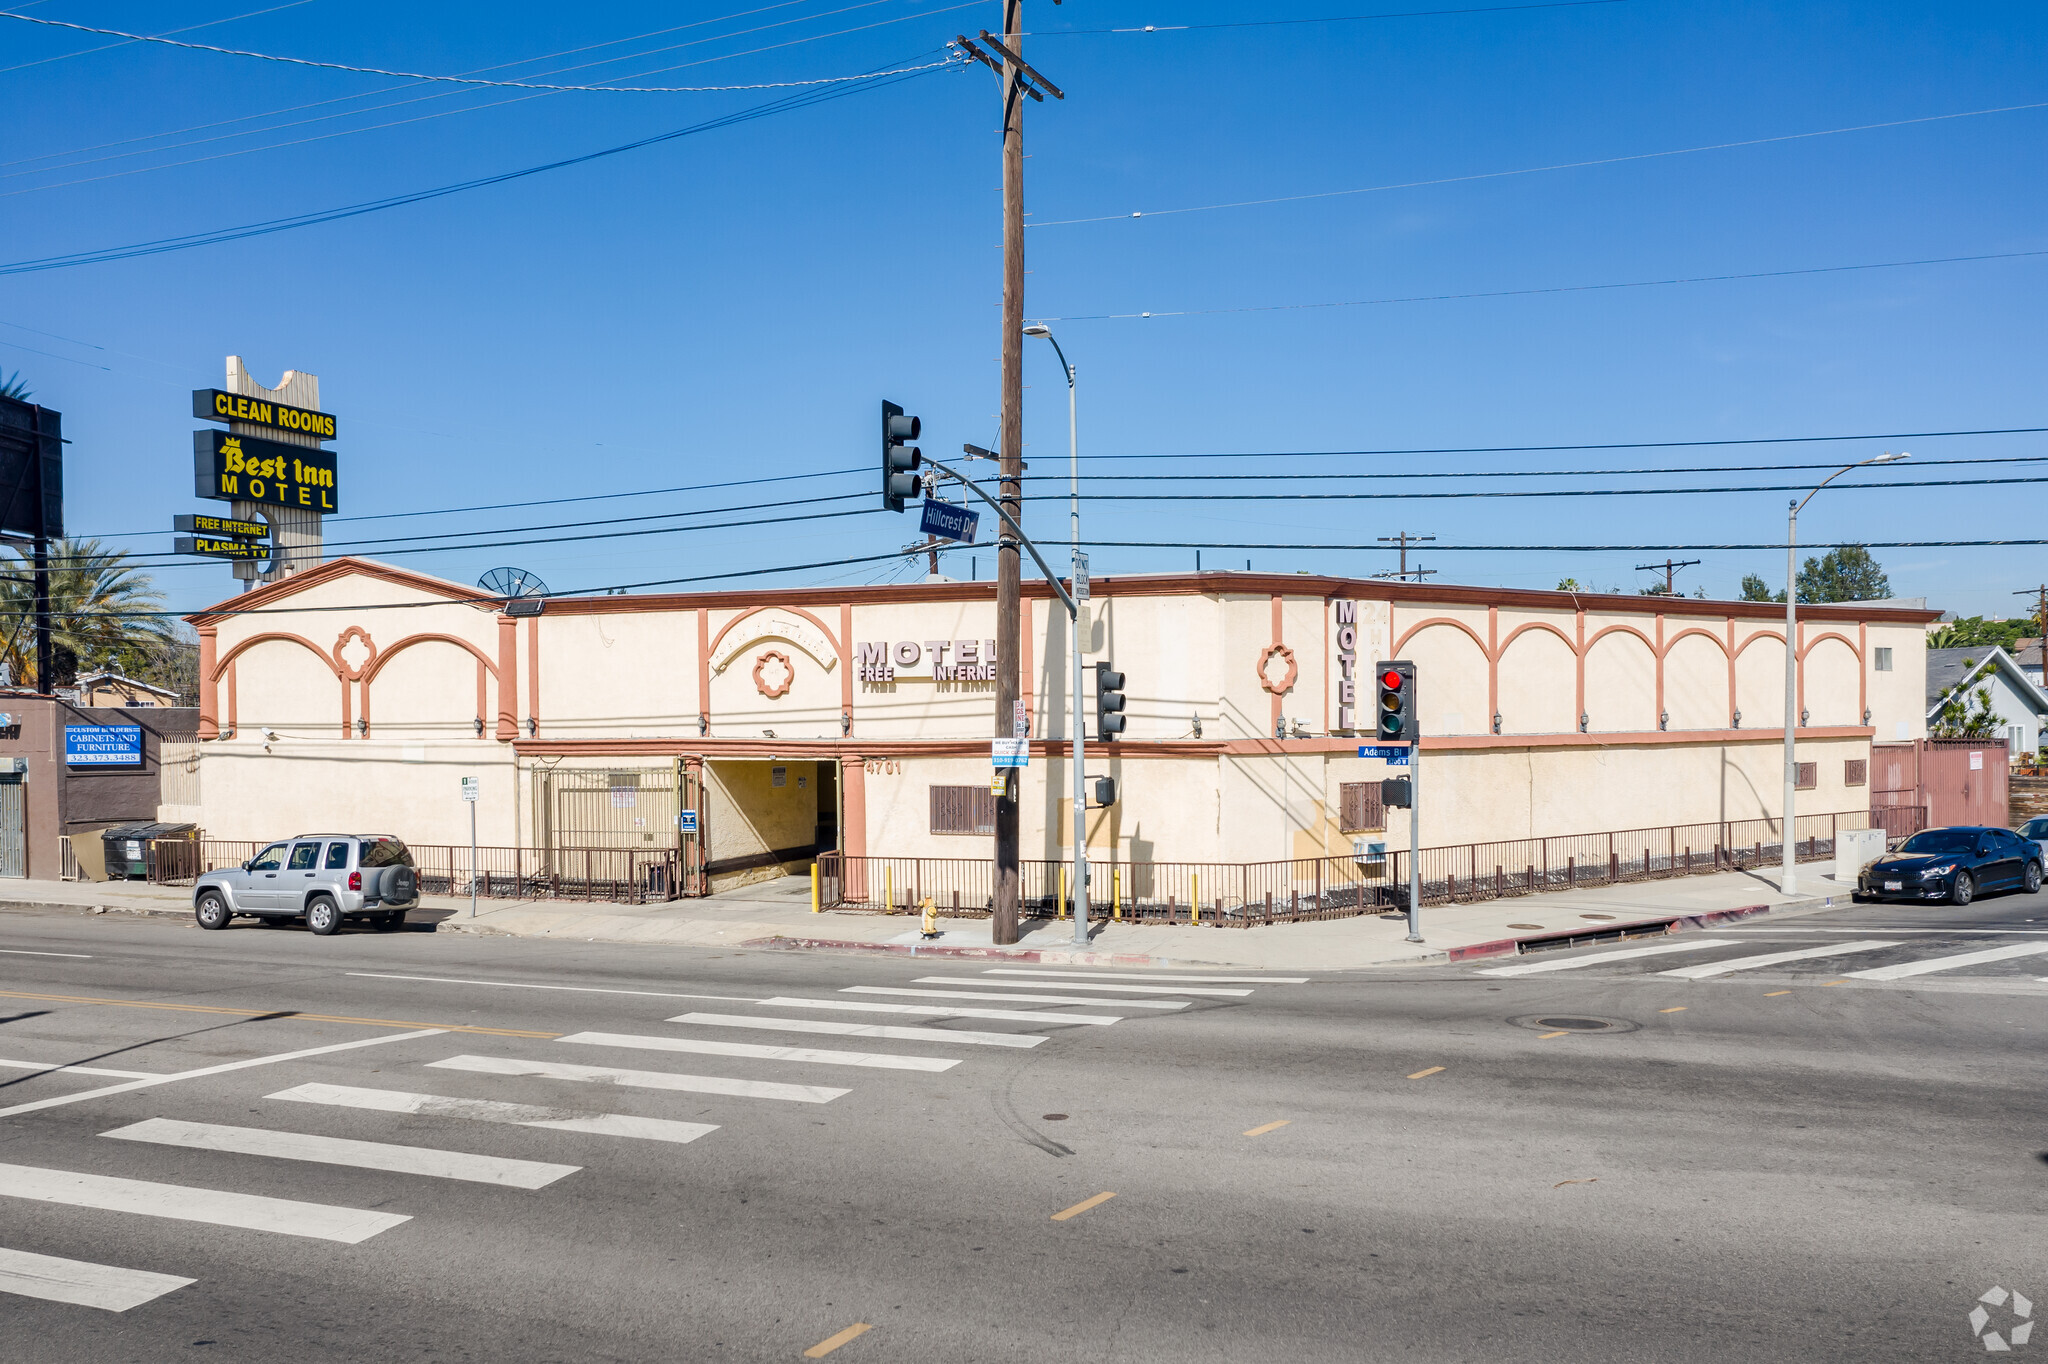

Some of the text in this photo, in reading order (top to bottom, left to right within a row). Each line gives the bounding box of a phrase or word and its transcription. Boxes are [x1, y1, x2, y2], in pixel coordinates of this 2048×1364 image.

[215, 394, 335, 436] CLEAN ROOMS
[219, 445, 334, 488] Best Inn
[221, 473, 334, 509] MOTEL
[195, 516, 268, 537] FREE INTERNET
[925, 506, 975, 535] Hillcrest Dr
[196, 539, 268, 558] PLASMA TV
[857, 665, 997, 681] FREE INTERNE
[1338, 600, 1358, 729] MOTEL
[70, 734, 137, 742] CABINETS AND
[77, 743, 131, 751] FURNITURE
[1363, 747, 1402, 757] Adams Bl
[865, 760, 901, 775] 4701
[396, 879, 409, 887] Jeep
